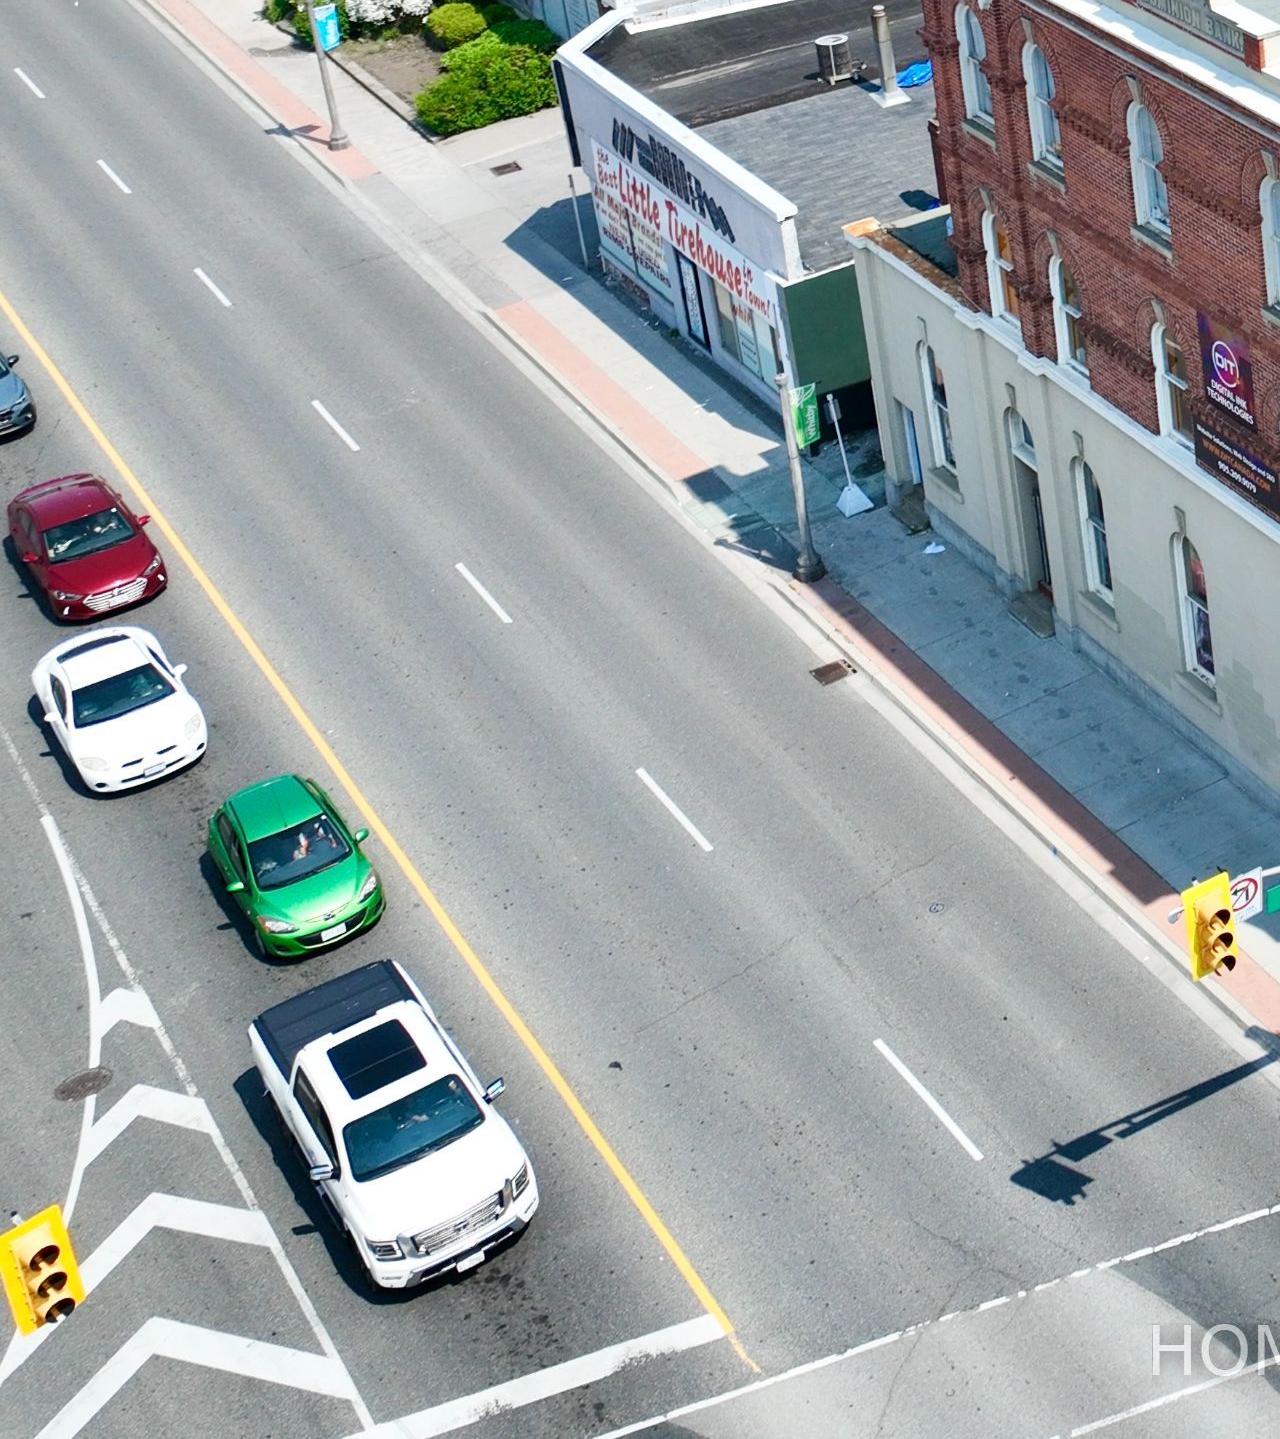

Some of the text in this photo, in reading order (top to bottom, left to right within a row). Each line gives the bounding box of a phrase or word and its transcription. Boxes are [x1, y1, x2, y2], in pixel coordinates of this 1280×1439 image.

[597, 163, 618, 190] Best
[618, 161, 661, 231] Little
[665, 199, 743, 298] Tirehouse
[1215, 352, 1235, 375] DIT
[1206, 385, 1254, 426] TECHNOLOGIES
[1210, 378, 1248, 411] DIGITAL INK
